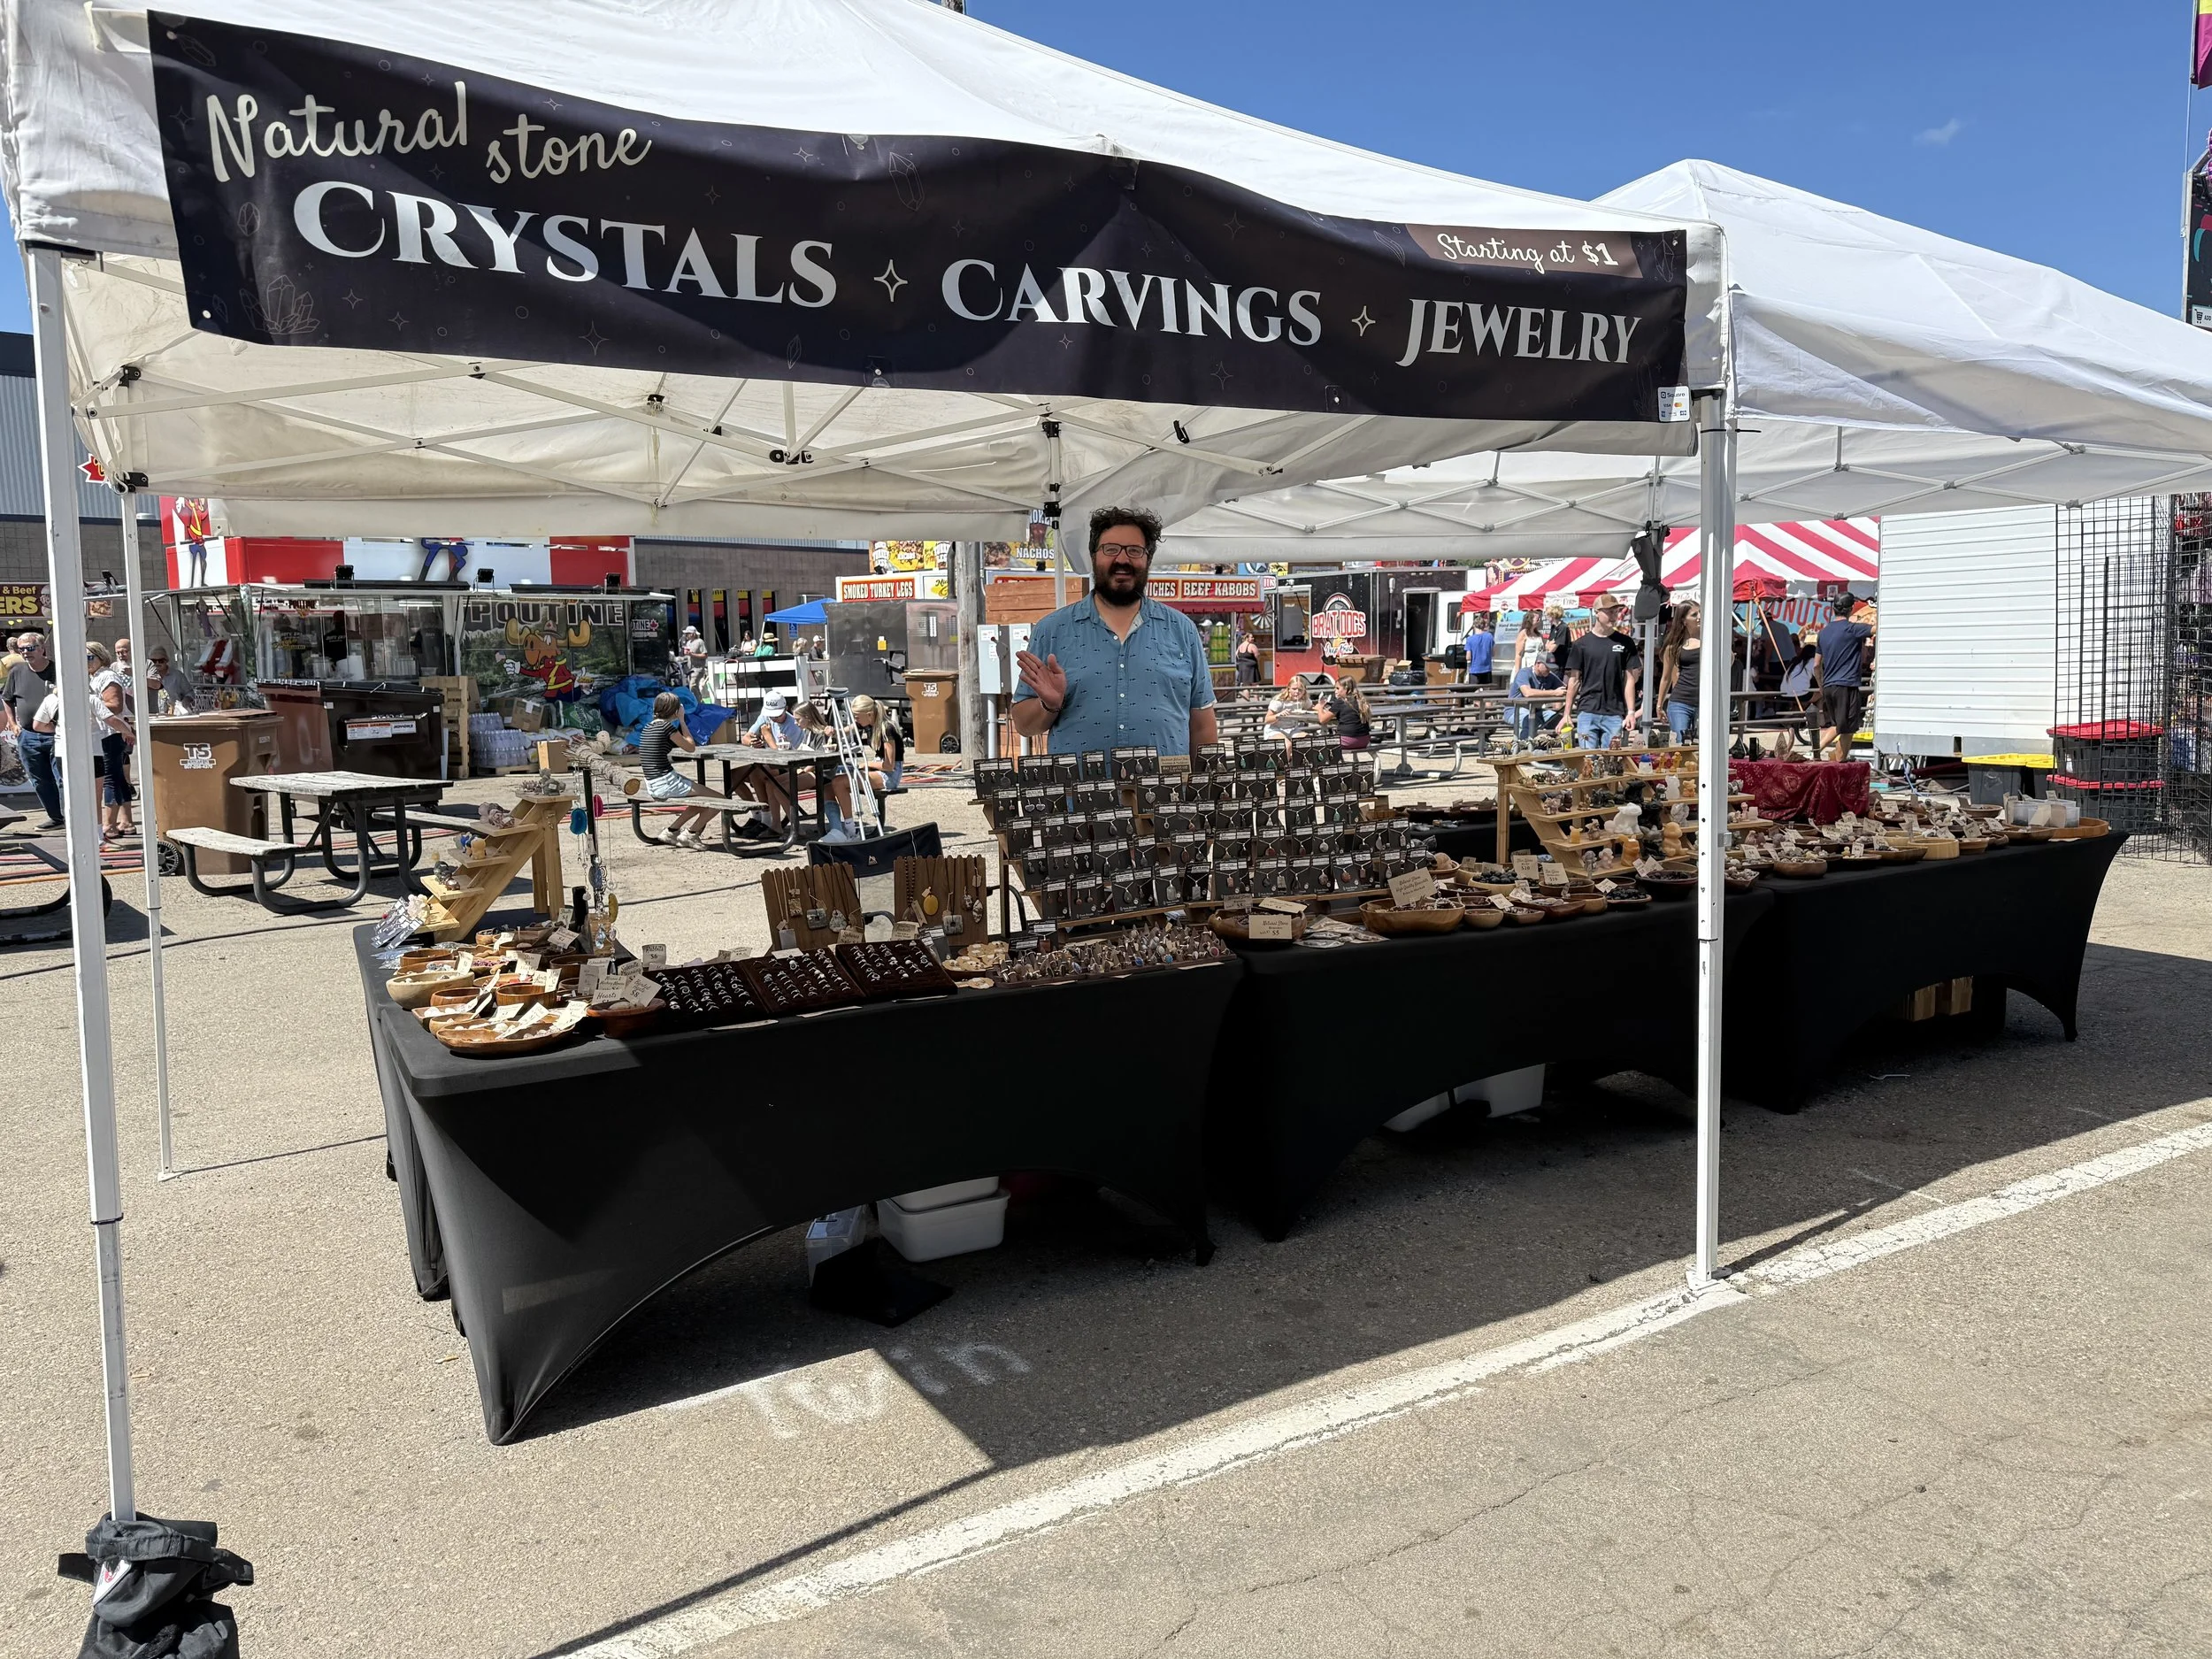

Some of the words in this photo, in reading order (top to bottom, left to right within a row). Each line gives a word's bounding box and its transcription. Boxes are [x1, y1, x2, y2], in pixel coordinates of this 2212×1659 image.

[207, 81, 467, 182] Natural
[487, 113, 652, 184] stone
[1437, 234, 1545, 274] Starting
[1550, 241, 1575, 263] at
[1582, 241, 1618, 265] $1
[294, 181, 837, 308] CRYSTALS
[942, 259, 1322, 346] CARVINGS
[1395, 297, 1643, 367] JEWELRY
[1017, 547, 1055, 560] NACHOS
[843, 585, 869, 600] SMOKED
[870, 581, 895, 598] TURKEY
[896, 580, 913, 597] LEGS
[1184, 582, 1211, 596] BEEF
[1215, 582, 1256, 596] KABOBS
[466, 600, 624, 626] POUTINE
[1313, 611, 1338, 637] BRAT
[1340, 611, 1365, 636] DOGS
[924, 683, 937, 692] TS
[184, 743, 211, 759] TS
